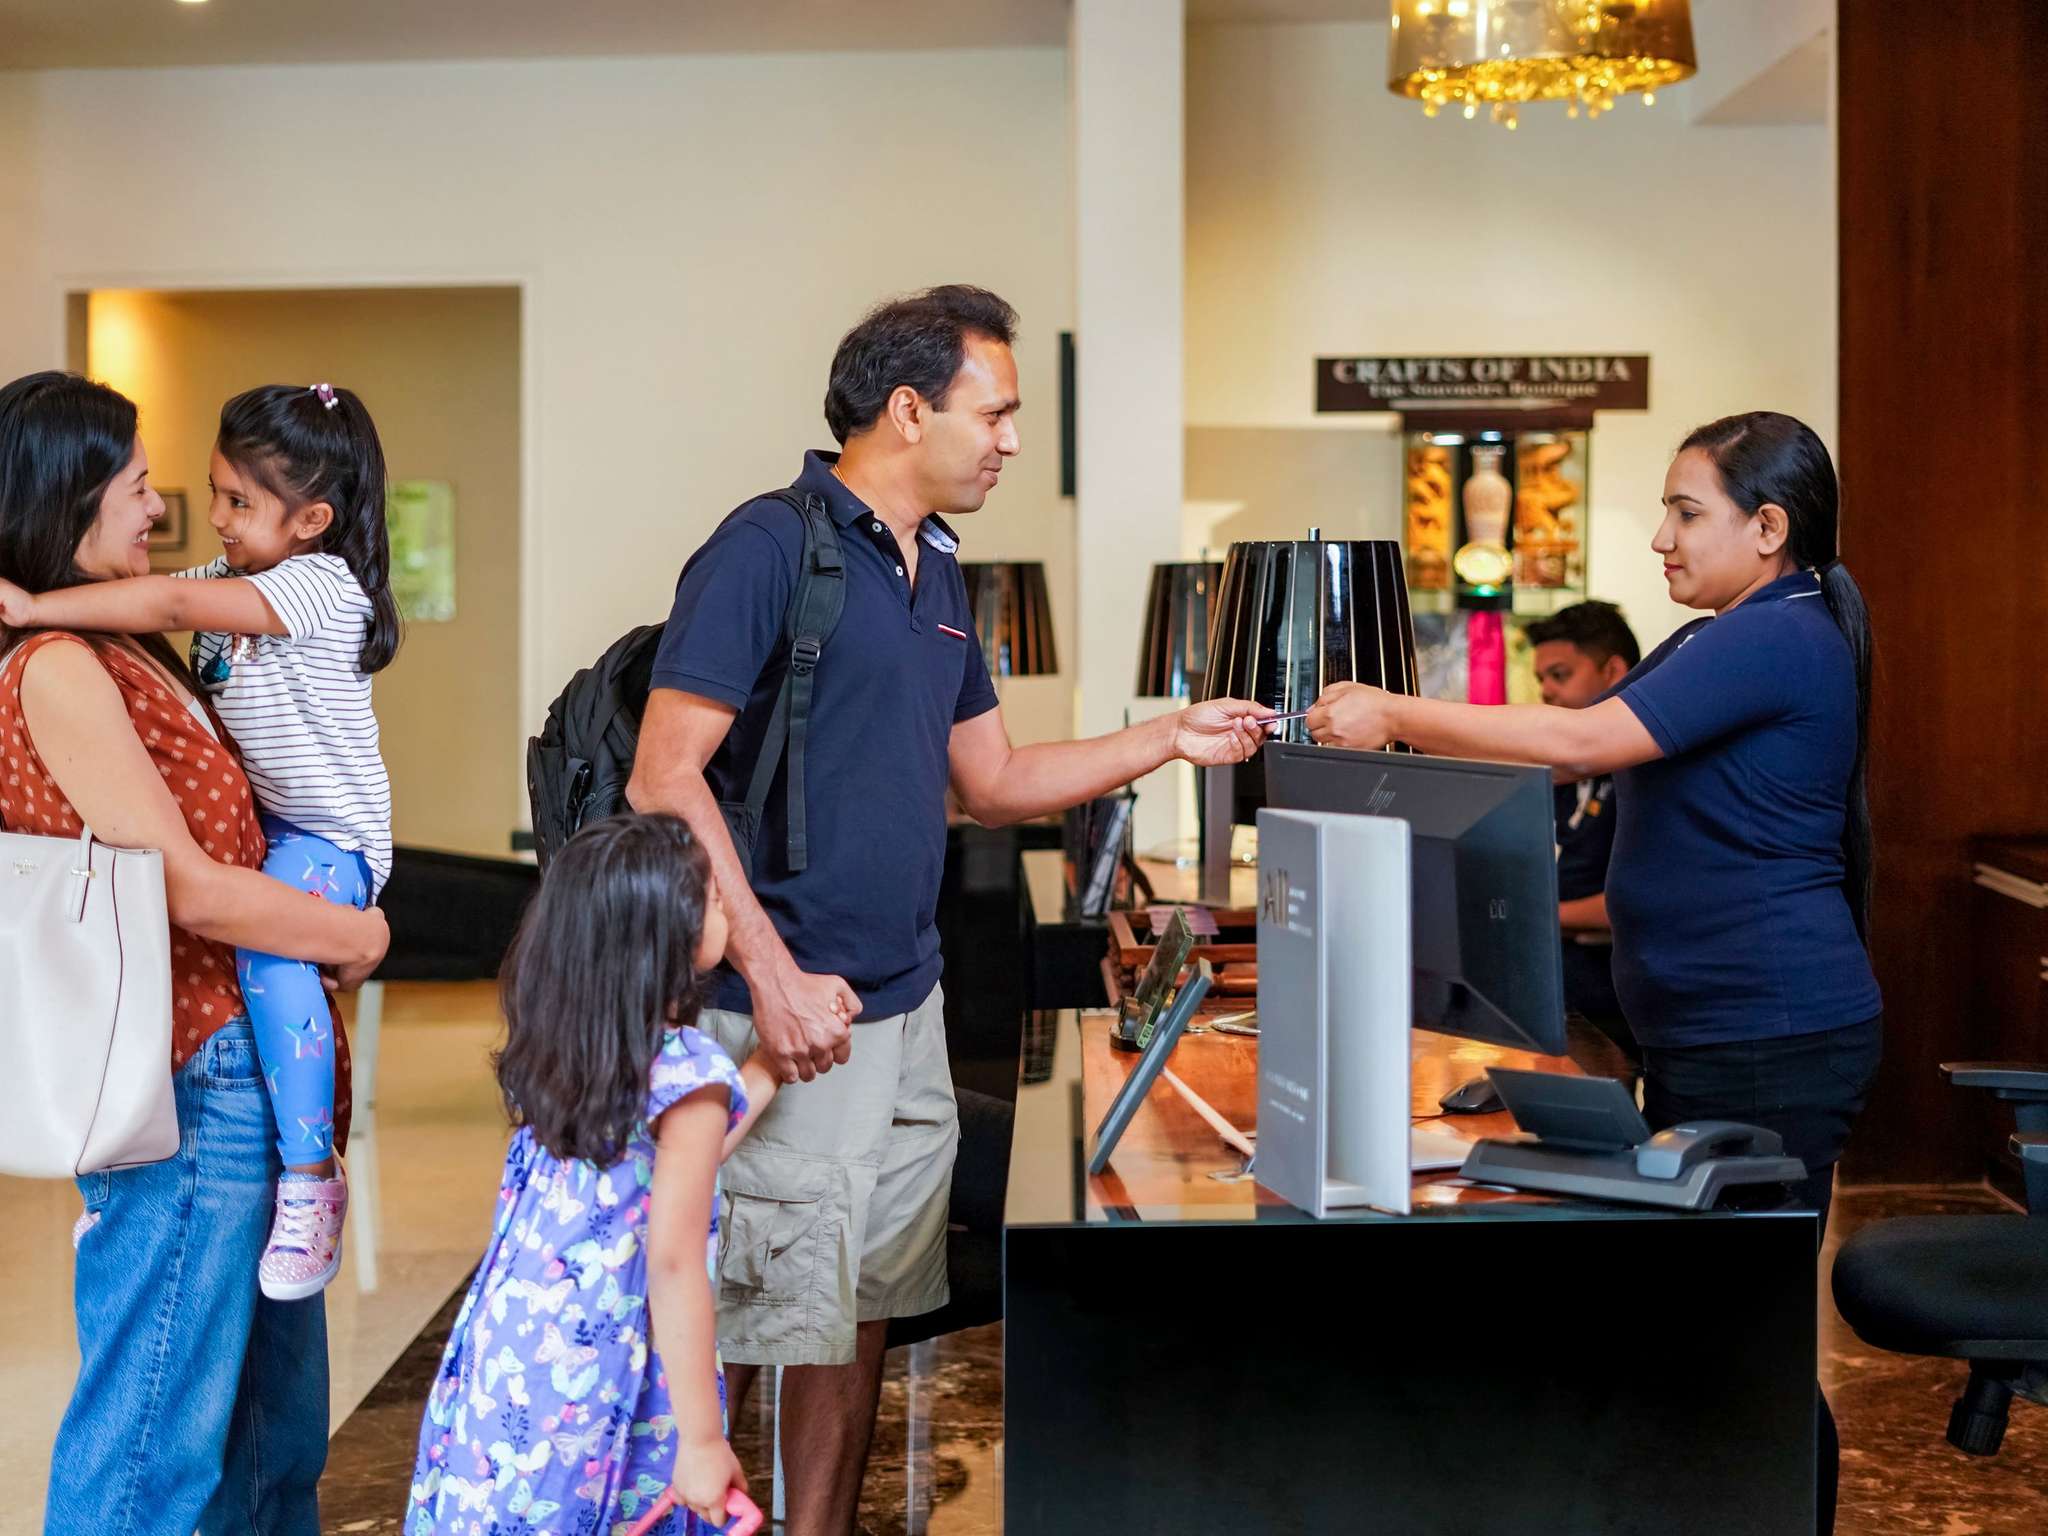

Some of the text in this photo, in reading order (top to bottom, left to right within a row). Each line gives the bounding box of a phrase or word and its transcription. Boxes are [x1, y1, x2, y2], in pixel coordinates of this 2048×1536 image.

[1332, 357, 1631, 384] CRAFTS OF INDIA
